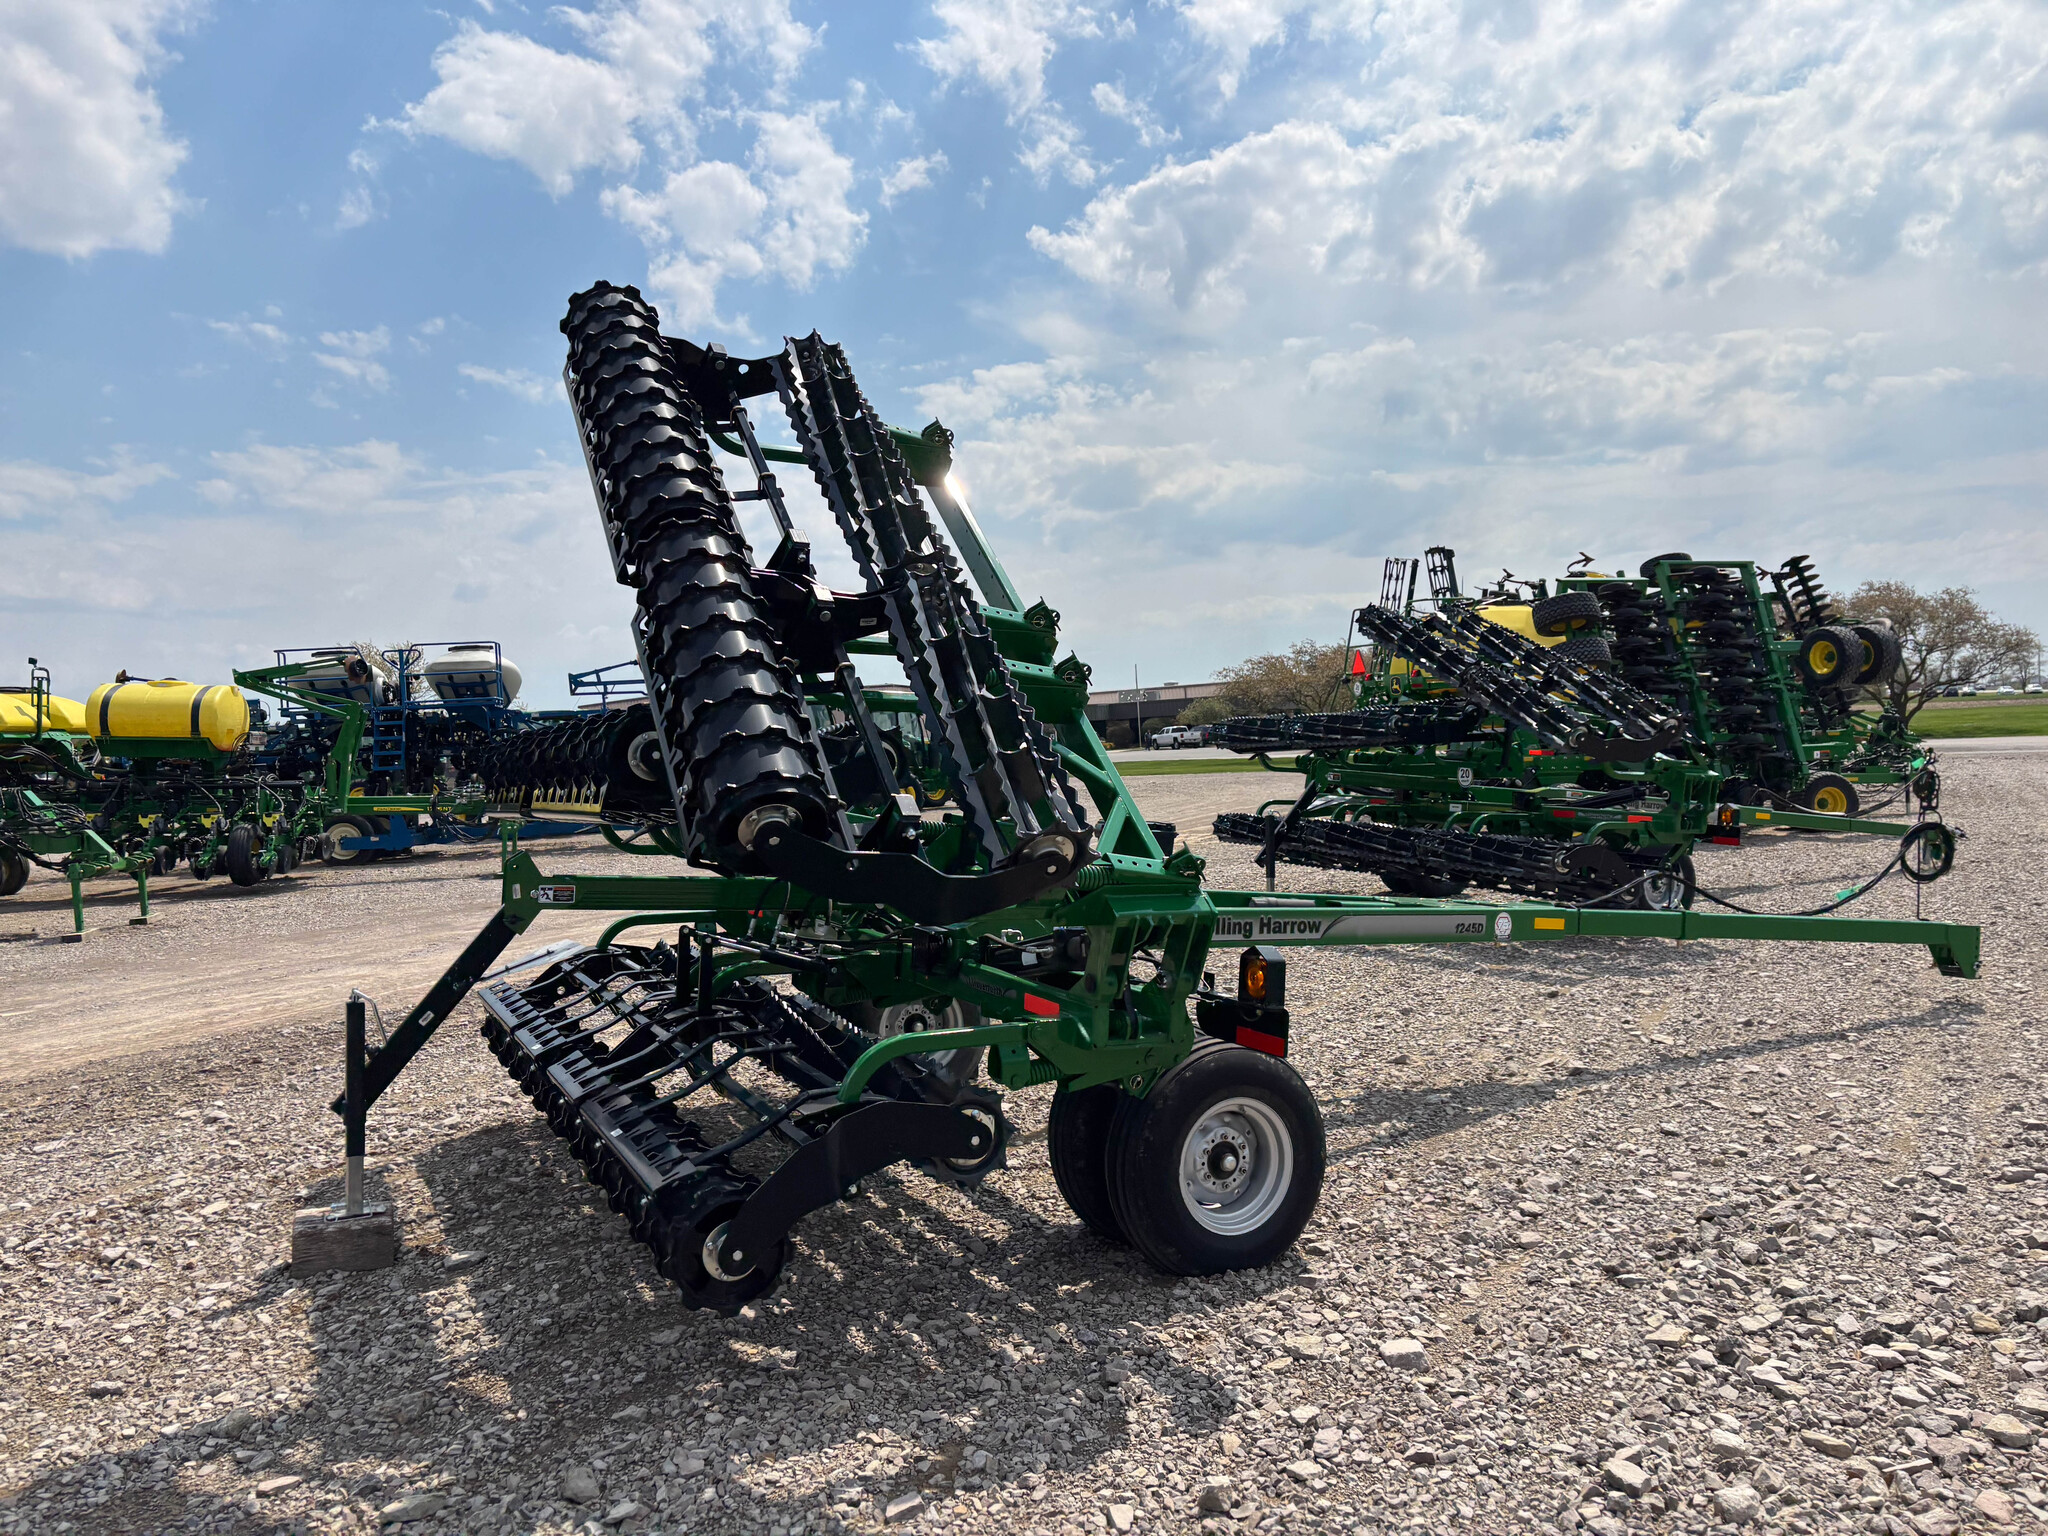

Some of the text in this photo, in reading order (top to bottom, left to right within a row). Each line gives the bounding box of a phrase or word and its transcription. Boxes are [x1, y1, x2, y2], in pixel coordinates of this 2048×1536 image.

[1460, 768, 1470, 779] 20
[1215, 916, 1321, 938] lling Harrow
[1455, 922, 1484, 934] 1245D
